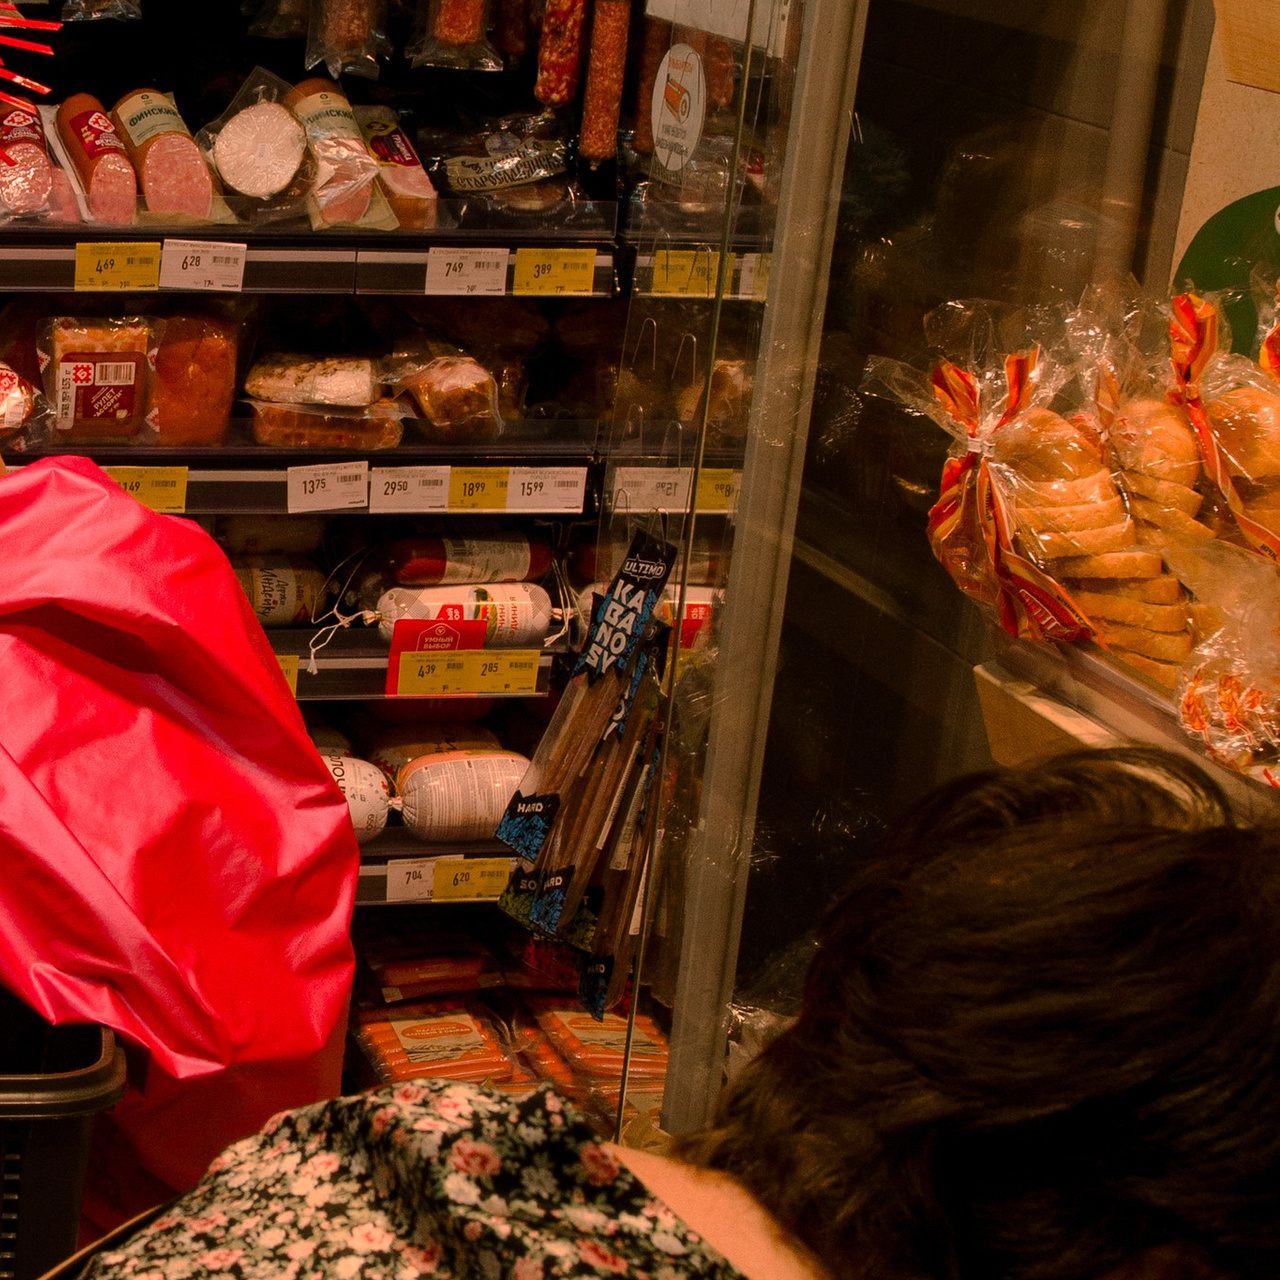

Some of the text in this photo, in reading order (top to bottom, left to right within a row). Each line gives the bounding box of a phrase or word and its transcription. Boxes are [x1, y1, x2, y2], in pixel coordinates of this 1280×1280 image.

[623, 559, 665, 578] ULTIMO
[422, 642, 451, 650] ВЫБОР
[516, 802, 544, 814] HARD
